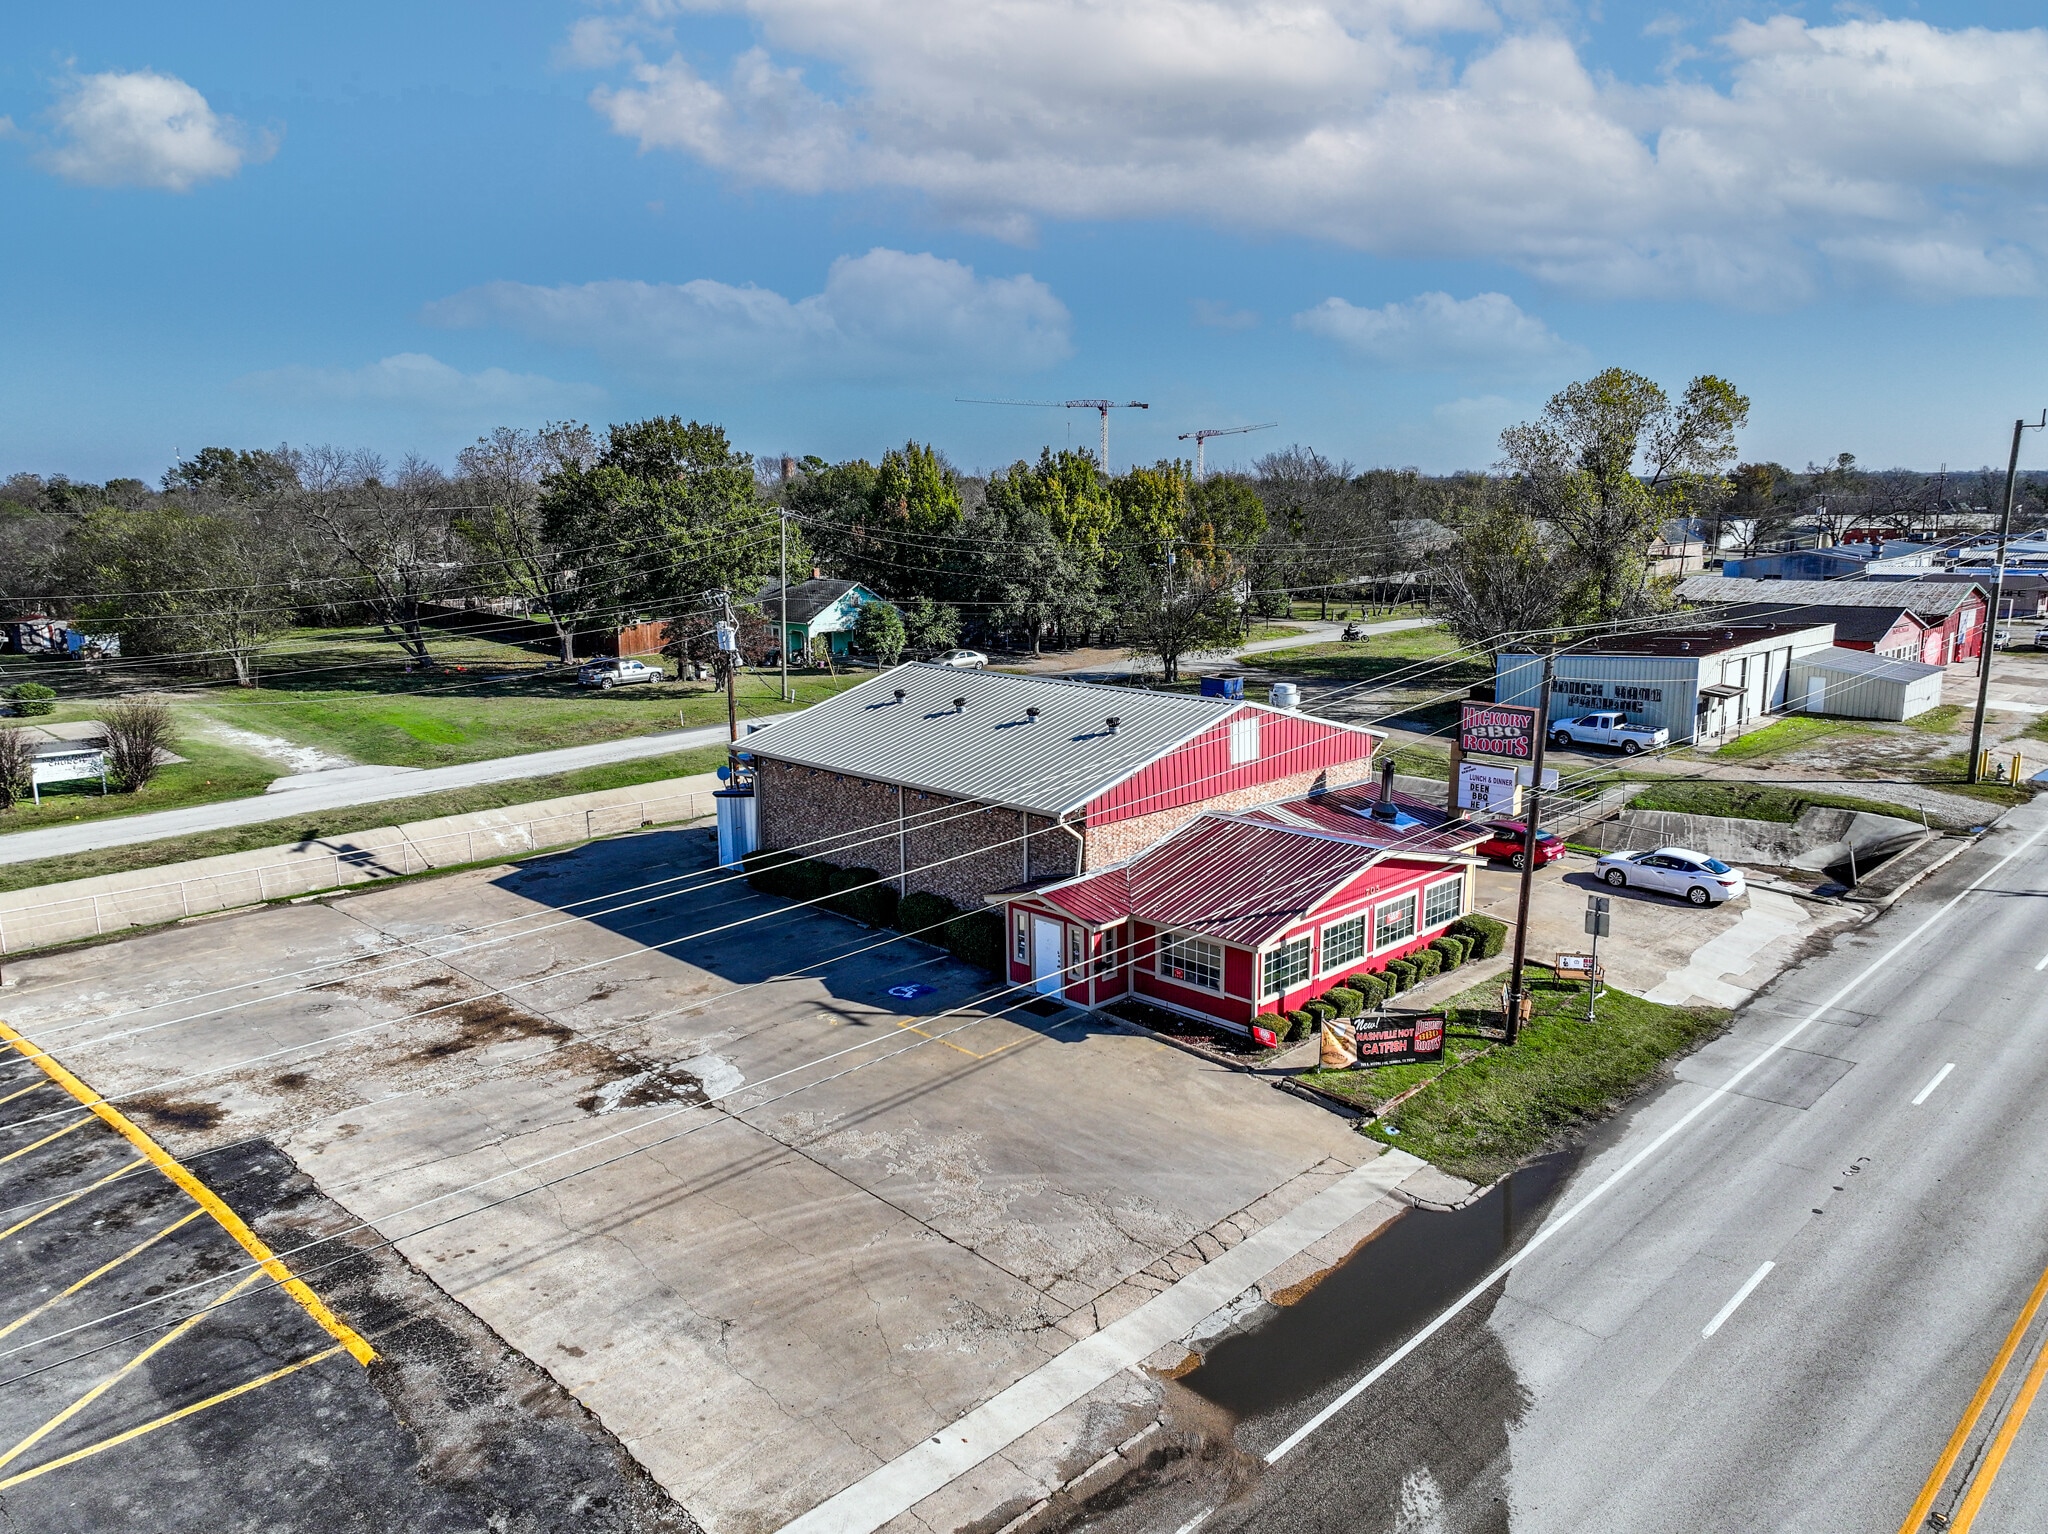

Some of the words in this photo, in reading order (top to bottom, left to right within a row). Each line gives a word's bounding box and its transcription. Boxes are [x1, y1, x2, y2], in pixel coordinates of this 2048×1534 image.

[1463, 707, 1531, 730] HICKORY
[1471, 726, 1521, 737] BBQ
[1463, 734, 1528, 756] ROOTS
[1469, 774, 1487, 783] LUNCH
[1493, 778, 1513, 787] DINNER
[1472, 792, 1488, 802] BBQ
[1354, 1017, 1379, 1030] New!
[1356, 1030, 1397, 1041] NASHVILLE
[1398, 1028, 1415, 1037] HOT
[1362, 1041, 1407, 1054] CATFISH
